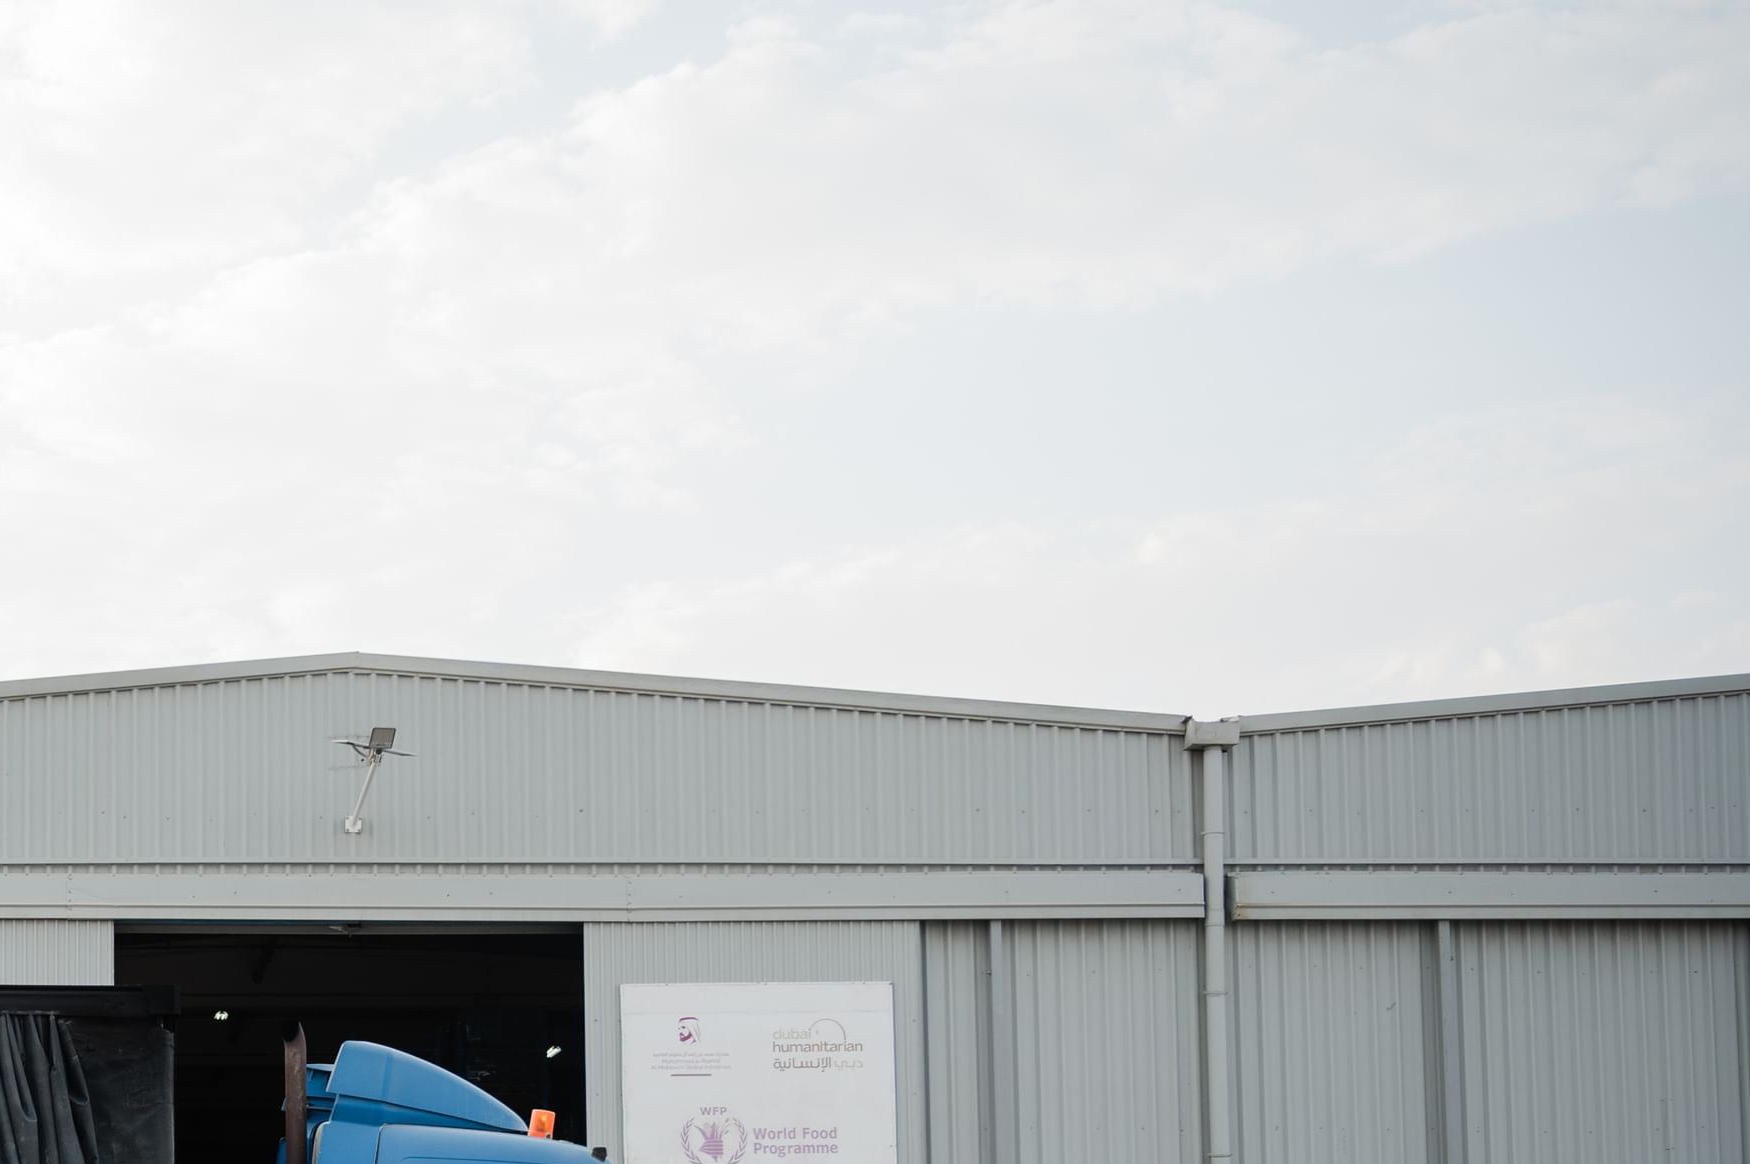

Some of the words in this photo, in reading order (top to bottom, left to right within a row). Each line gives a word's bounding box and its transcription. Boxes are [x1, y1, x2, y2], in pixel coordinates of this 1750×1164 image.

[772, 1028, 812, 1040] dubai
[772, 1041, 863, 1052] humanitarian
[700, 1106, 727, 1116] WFP
[753, 1127, 796, 1140] World
[802, 1127, 837, 1140] Food
[753, 1142, 838, 1158] Programme
